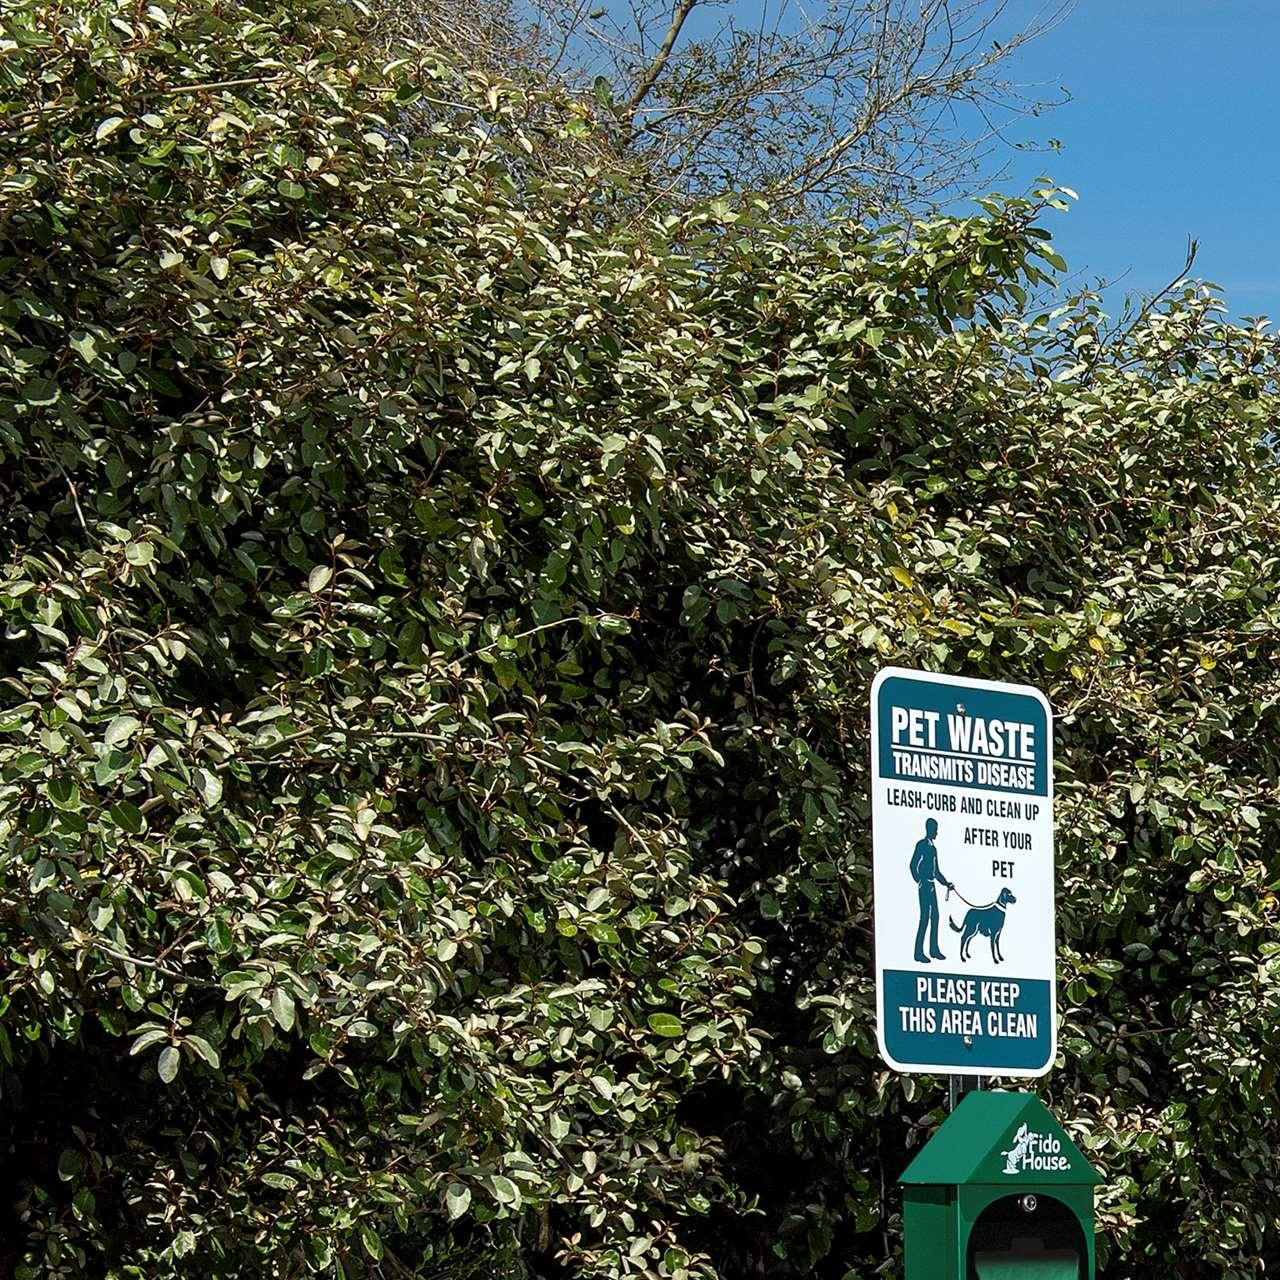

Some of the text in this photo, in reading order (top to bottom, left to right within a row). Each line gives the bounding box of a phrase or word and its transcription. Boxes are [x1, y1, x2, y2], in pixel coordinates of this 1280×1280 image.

[892, 706, 1035, 760] PET WASTE
[892, 751, 1035, 790] TRANSMITS DISEASE
[887, 788, 1040, 821] LEASH-CURB AND CLEAN UP
[964, 827, 1032, 851] AFTER YOUR
[992, 860, 1015, 879] PET
[916, 977, 1020, 1008] PLEASE KEEP
[899, 1006, 1037, 1039] THIS AREA CLEAN
[1028, 1133, 1060, 1154] Fido
